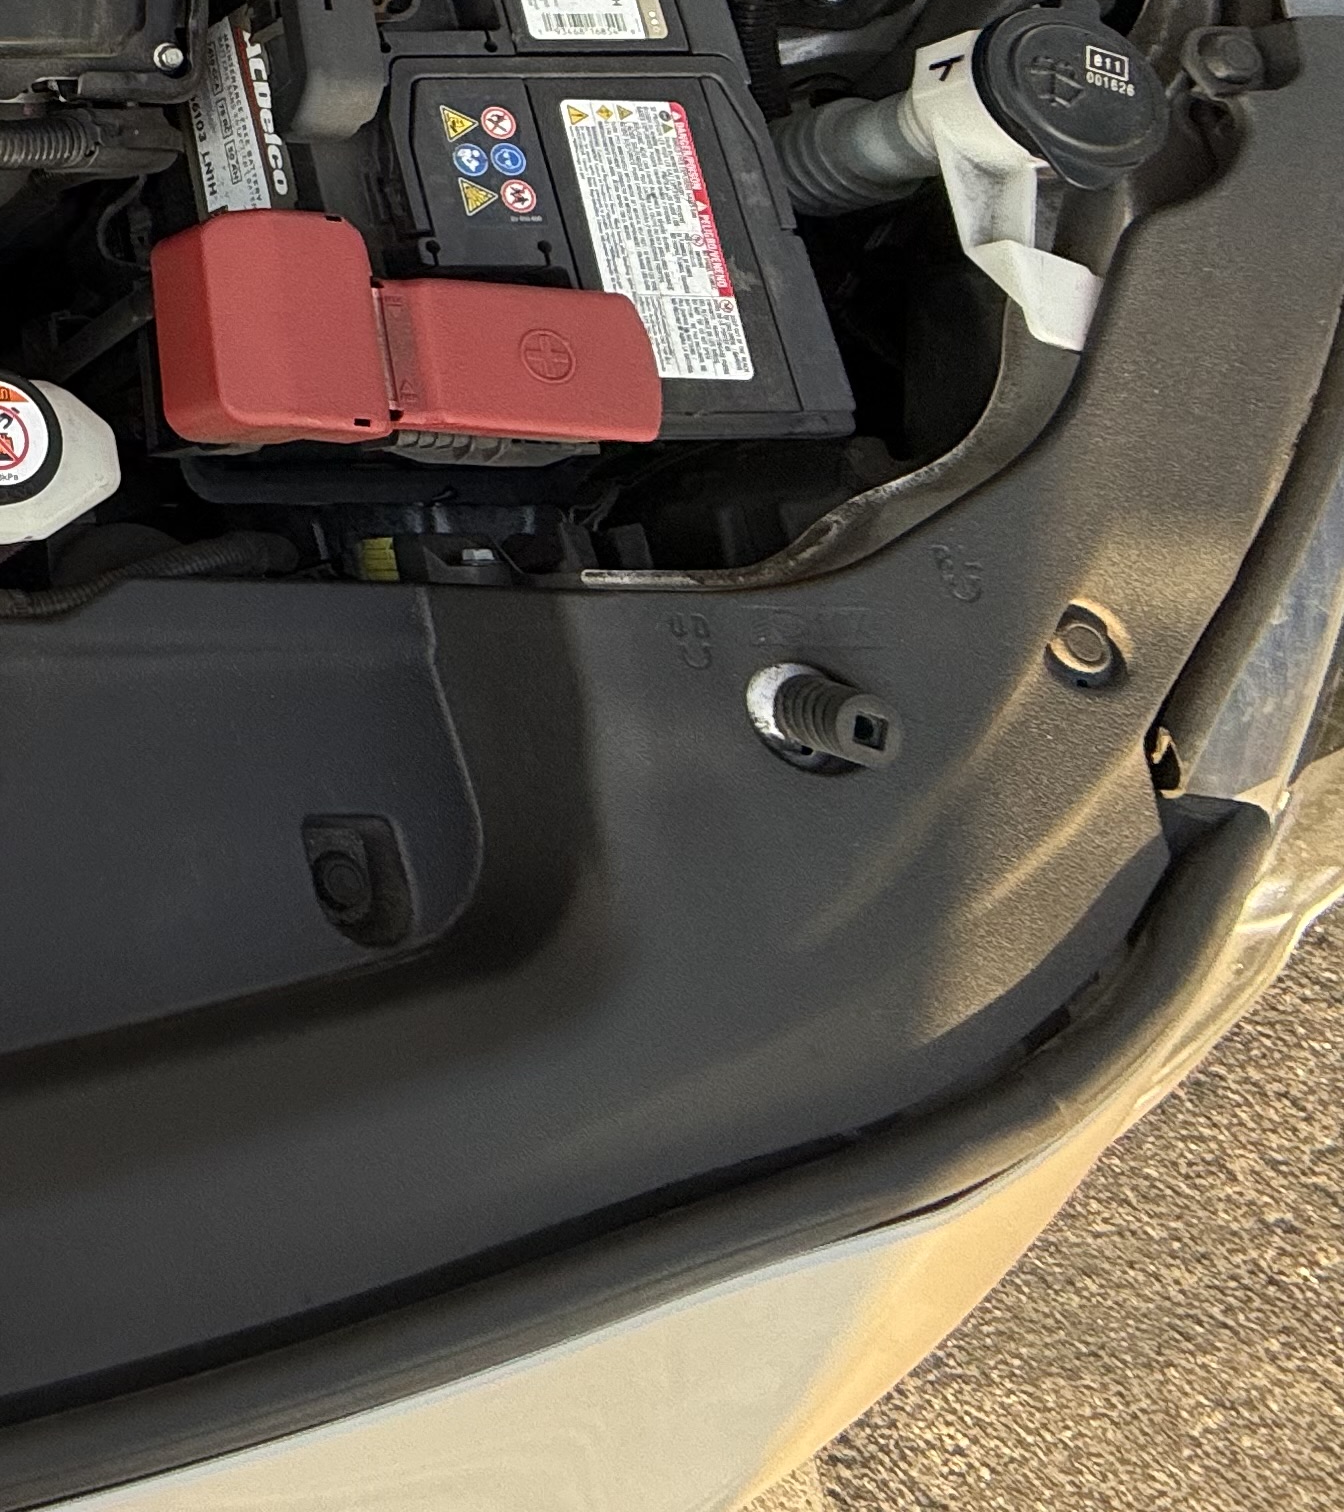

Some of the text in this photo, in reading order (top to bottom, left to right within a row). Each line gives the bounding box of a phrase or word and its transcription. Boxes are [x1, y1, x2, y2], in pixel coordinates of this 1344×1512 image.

[200, 150, 218, 197] LN1H
[222, 33, 243, 112] MAINTENANCE
[245, 150, 262, 201] BATTERY
[242, 29, 288, 196] ACDelco
